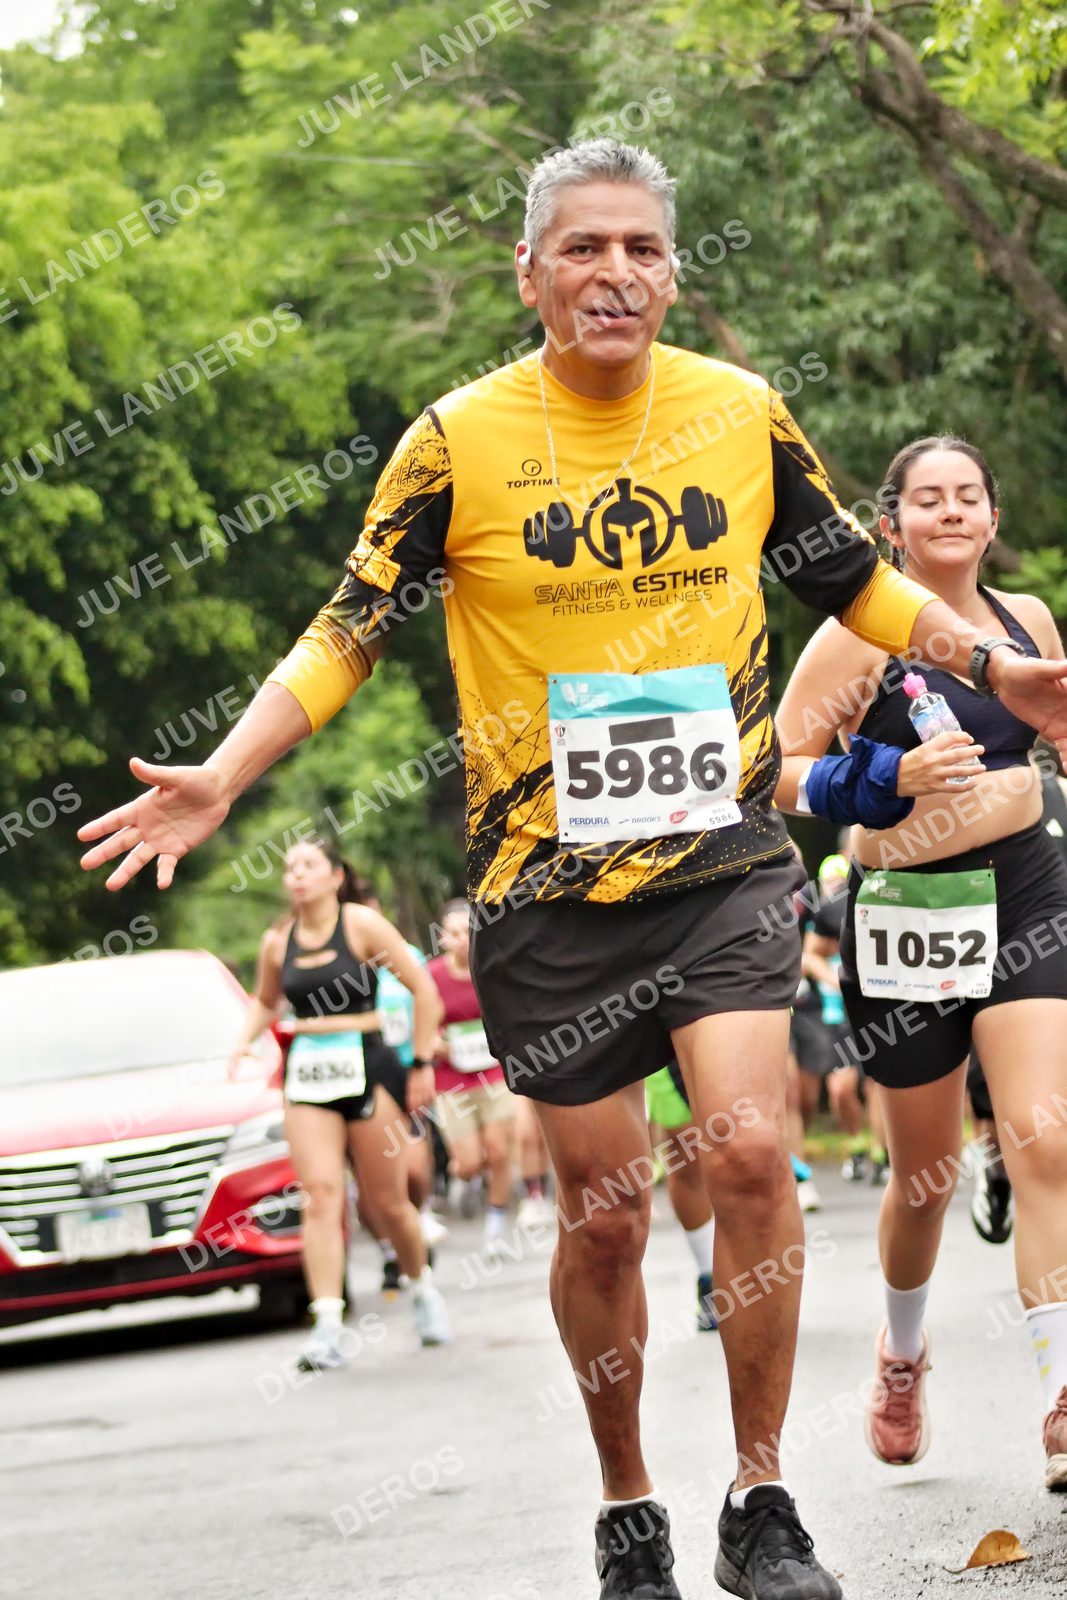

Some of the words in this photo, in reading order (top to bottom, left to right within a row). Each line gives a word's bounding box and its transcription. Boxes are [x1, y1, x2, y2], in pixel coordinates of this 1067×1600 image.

[507, 478, 560, 489] TOPTIME
[534, 578, 624, 604] SANTA
[632, 566, 728, 593] ESTHER
[552, 598, 615, 616] FITNESS
[620, 599, 631, 610] &
[635, 588, 713, 608] WELLNESS
[566, 742, 727, 800] 5986
[569, 817, 610, 826] PERDURA
[709, 812, 734, 825] 5986
[869, 928, 986, 970] 1052
